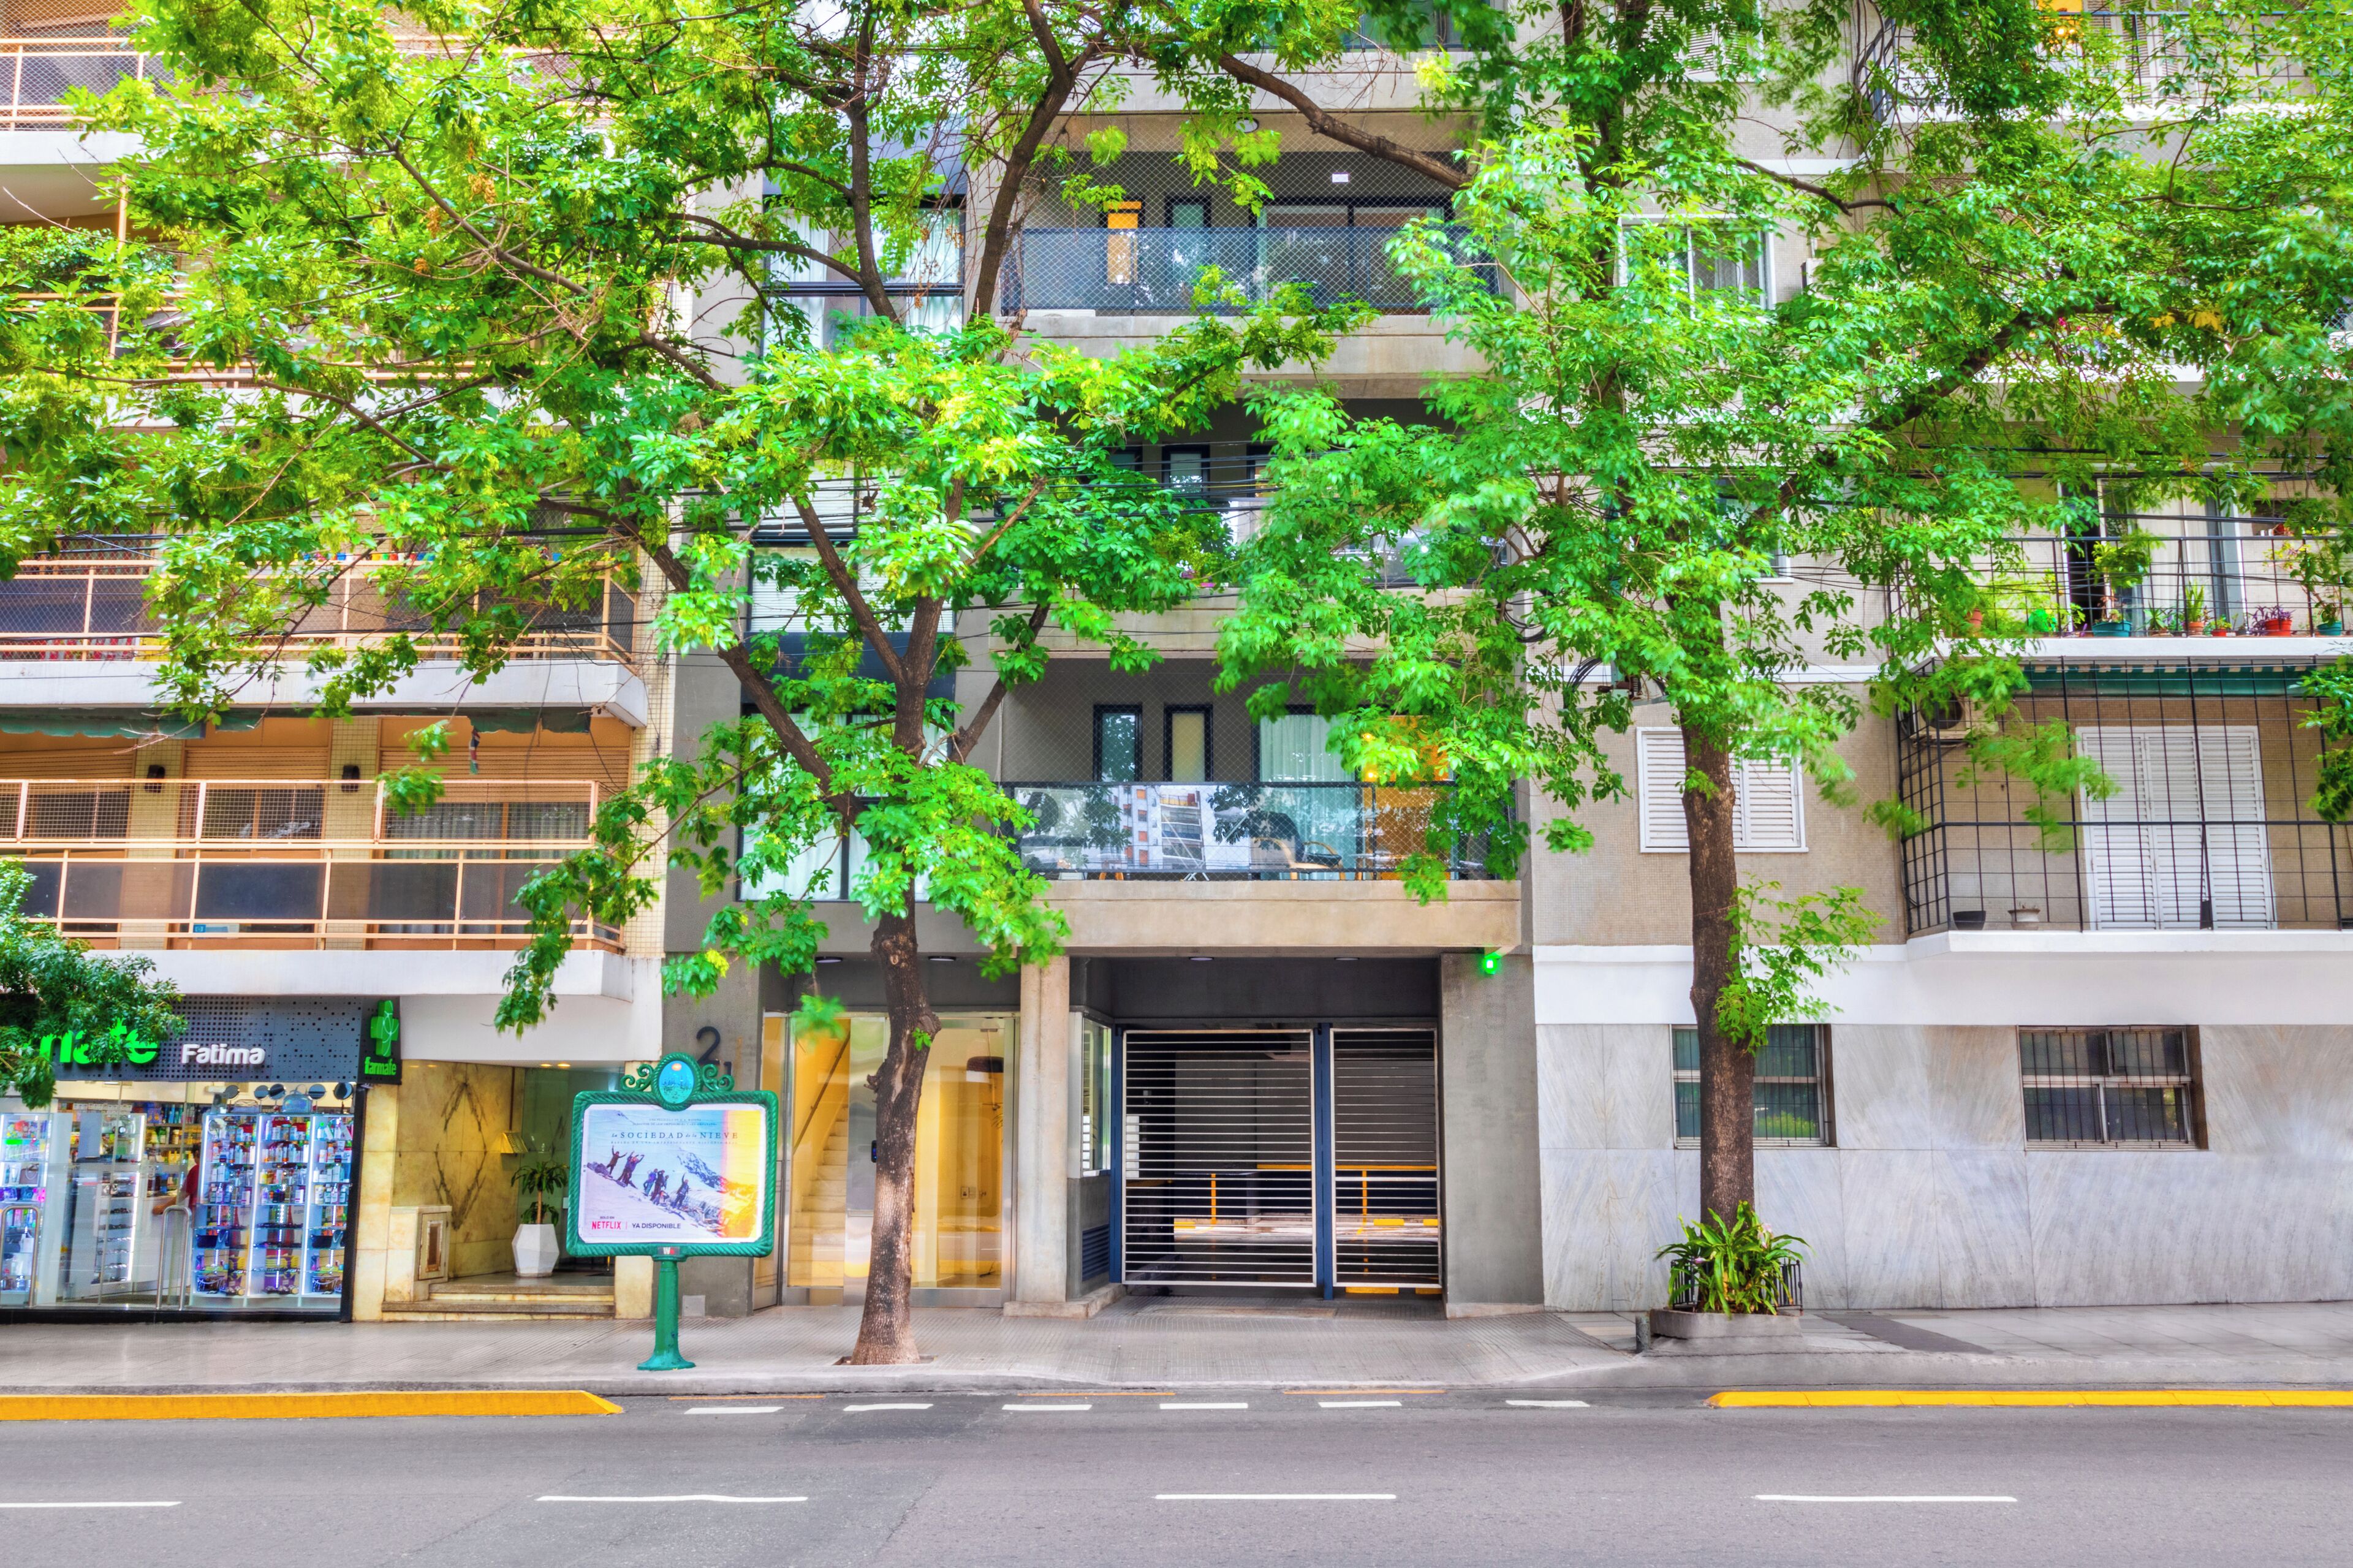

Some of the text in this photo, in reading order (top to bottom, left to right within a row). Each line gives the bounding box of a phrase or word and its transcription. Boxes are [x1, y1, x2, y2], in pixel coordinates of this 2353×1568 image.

[181, 1043, 266, 1064] Fatima
[364, 1056, 397, 1076] farmafe
[592, 1221, 621, 1230] NETFLIX
